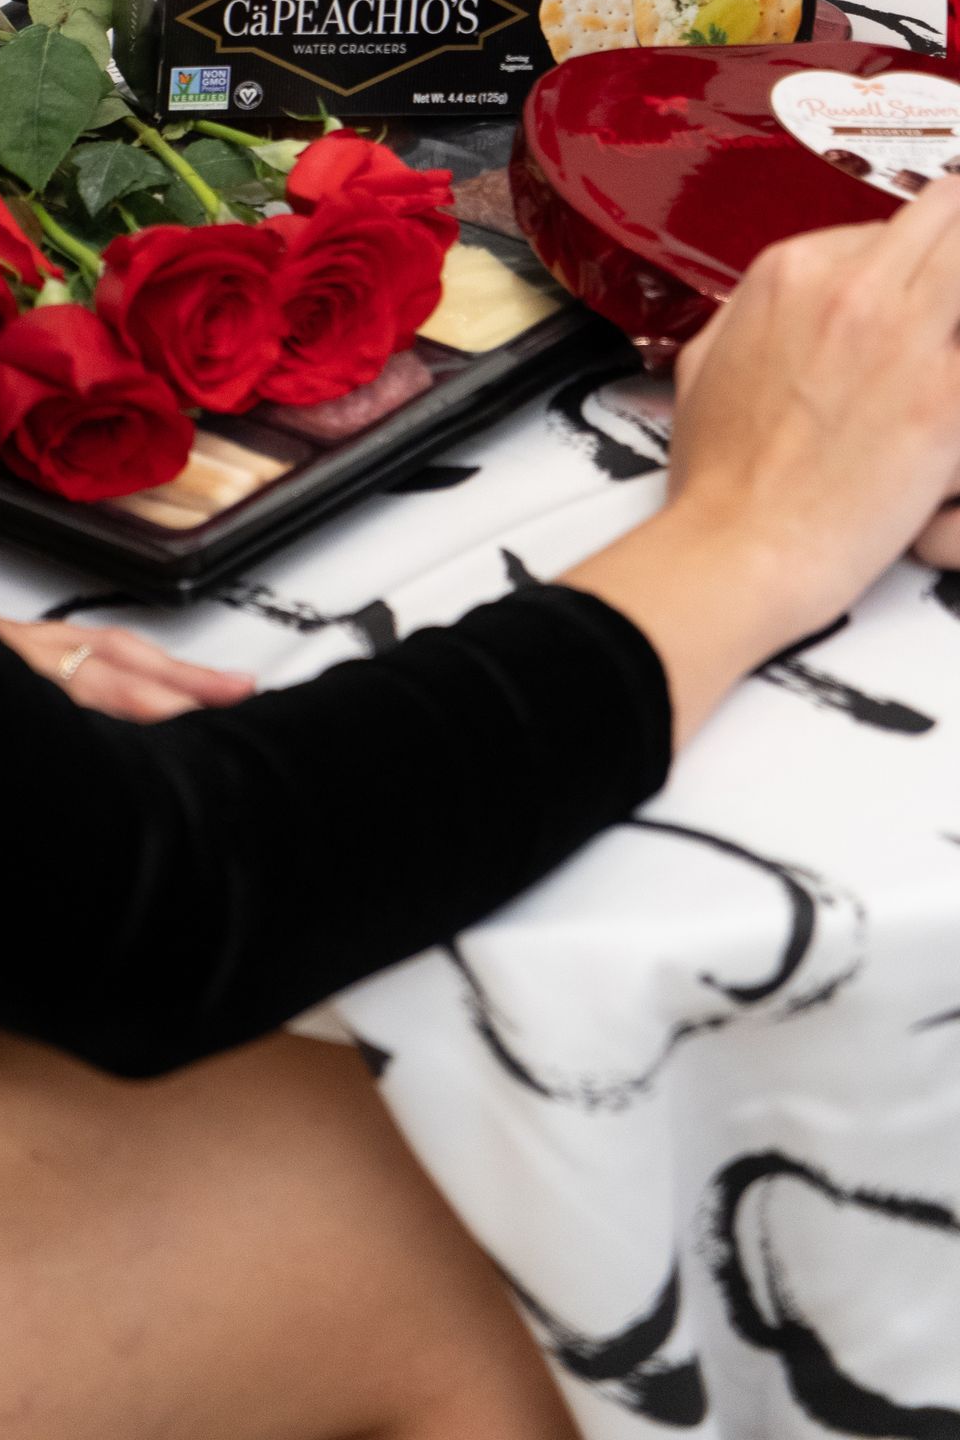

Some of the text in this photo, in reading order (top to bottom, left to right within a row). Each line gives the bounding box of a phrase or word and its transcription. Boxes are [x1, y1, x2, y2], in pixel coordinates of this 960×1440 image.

[293, 43, 407, 55] WATER CRACKERS
[203, 70, 226, 78] NON
[202, 78, 226, 86] GMO
[173, 94, 225, 102] VERIFIED
[413, 92, 508, 105] Net Wt. 4.4 oz (125g)
[798, 98, 883, 121] Russell
